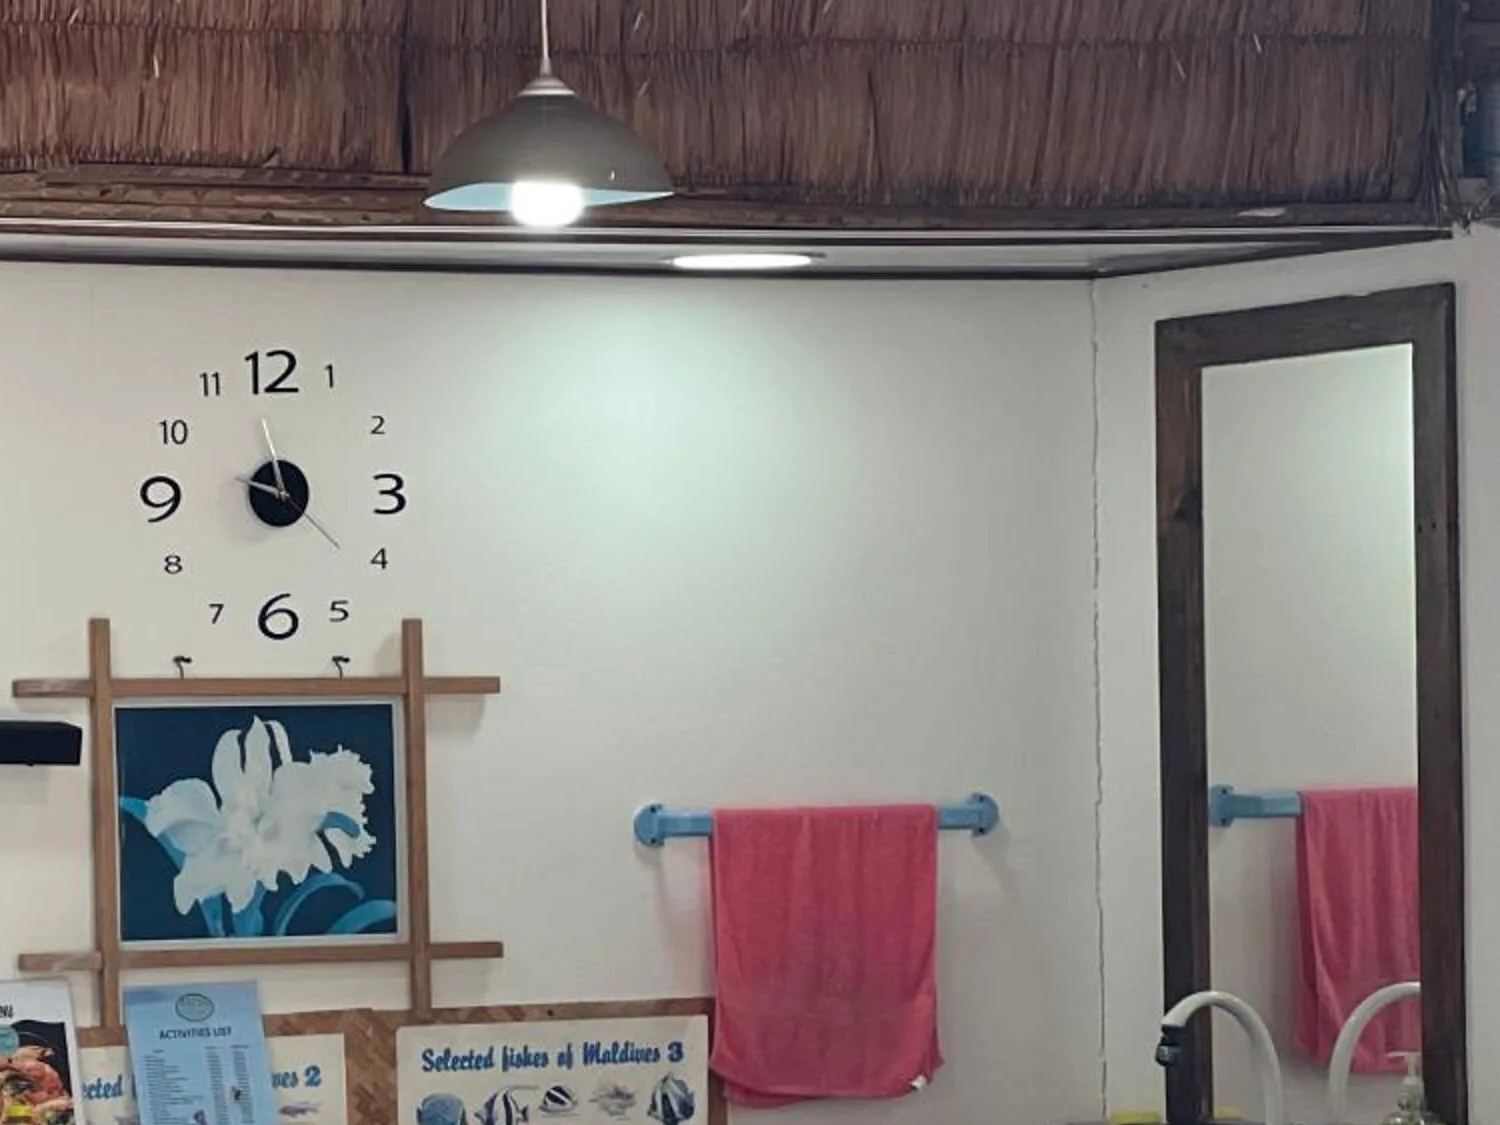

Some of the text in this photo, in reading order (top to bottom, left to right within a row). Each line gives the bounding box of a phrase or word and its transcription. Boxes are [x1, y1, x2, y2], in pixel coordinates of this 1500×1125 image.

[199, 371, 222, 397] 11
[244, 349, 299, 395] 12
[323, 363, 335, 389] 1
[158, 418, 189, 445] 10
[369, 415, 386, 435] 2
[139, 475, 182, 523] 9
[372, 473, 407, 515] 3
[163, 554, 184, 574] 8
[369, 547, 389, 570] 4
[208, 603, 225, 625] 7
[257, 592, 299, 640] 6
[329, 599, 350, 623] 5
[158, 1025, 232, 1041] ACTIVITIES LIST
[422, 1046, 495, 1073] Selected
[556, 1042, 574, 1070] of
[582, 1041, 661, 1066] Maldives
[668, 1041, 684, 1062] 3
[304, 1064, 323, 1088] 2
